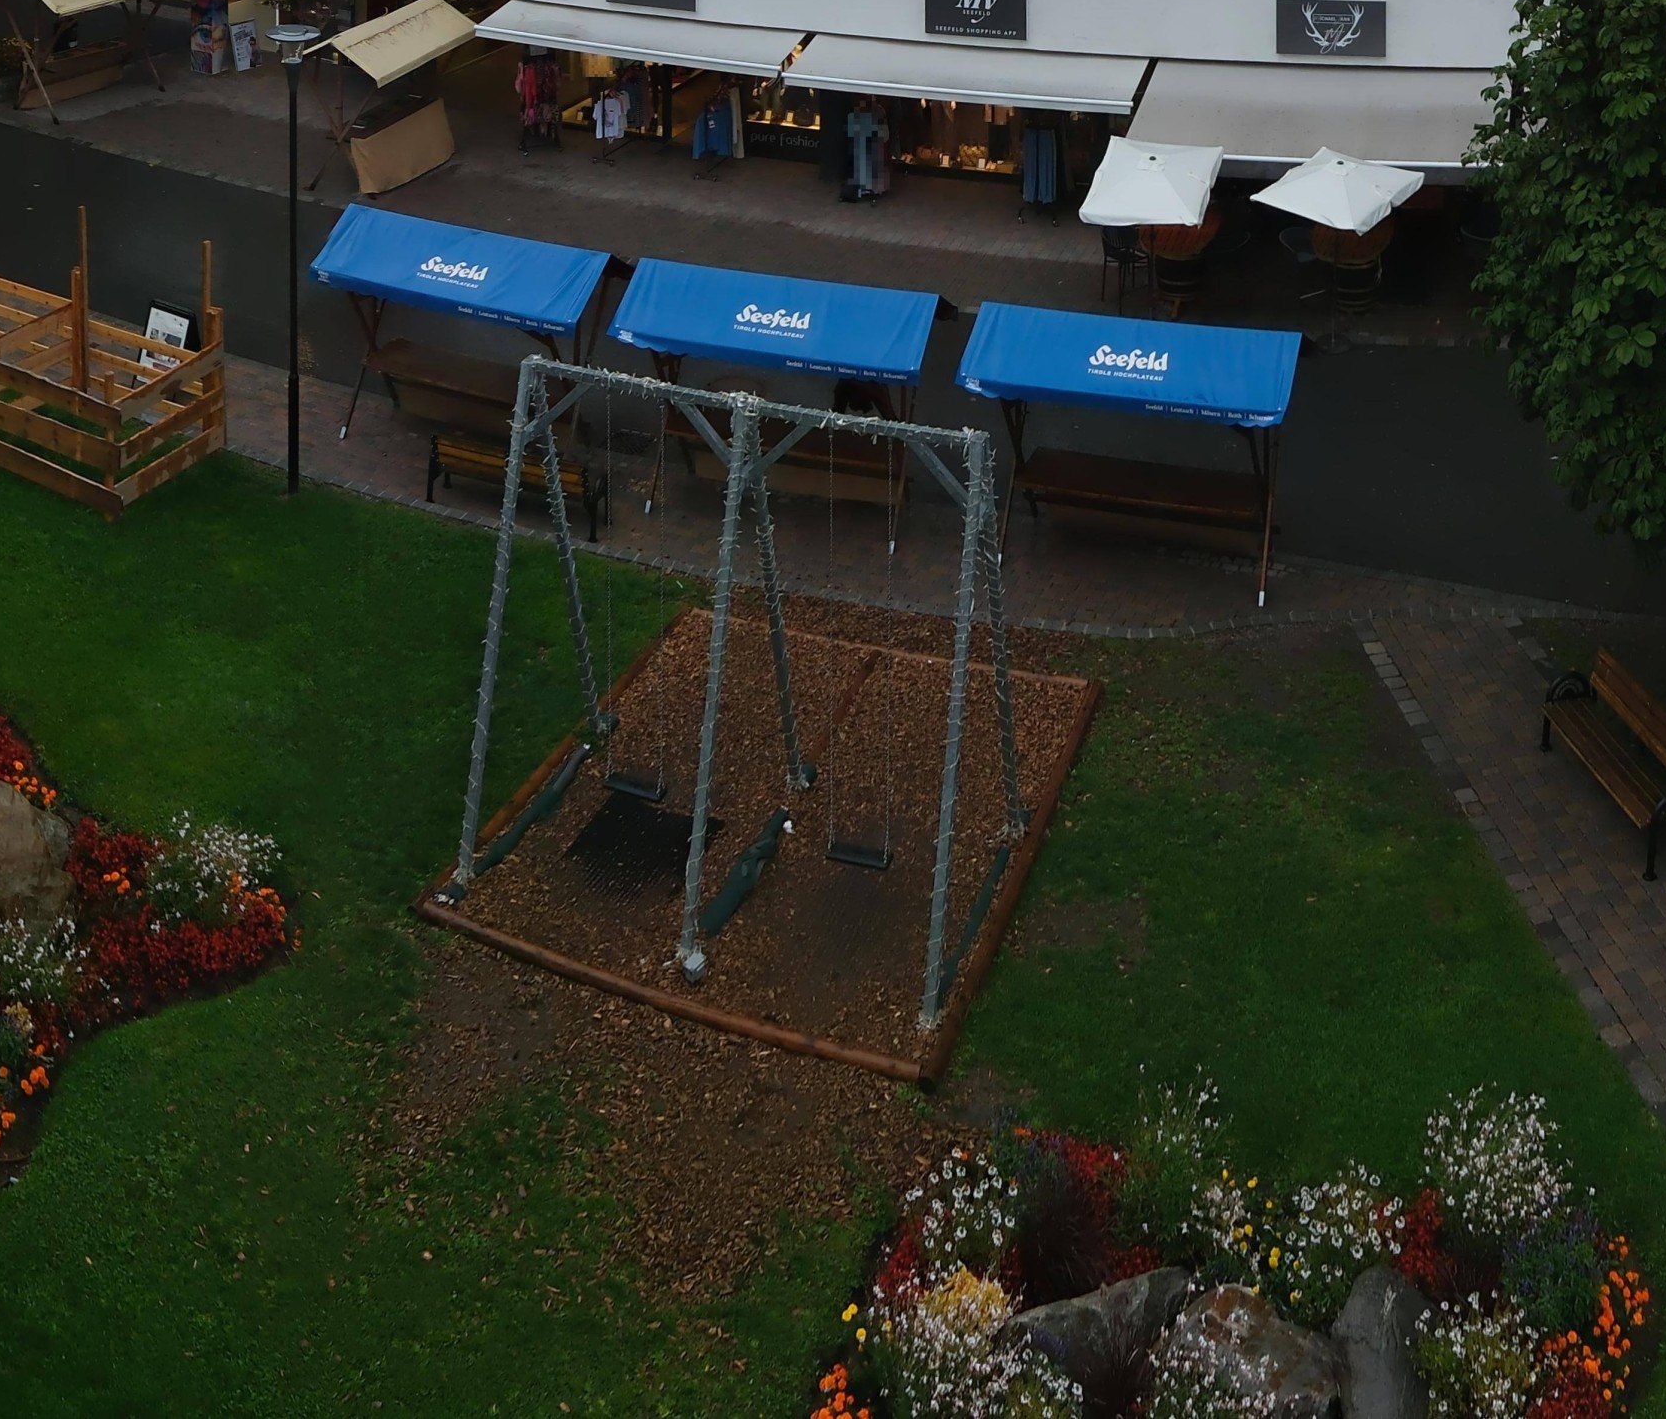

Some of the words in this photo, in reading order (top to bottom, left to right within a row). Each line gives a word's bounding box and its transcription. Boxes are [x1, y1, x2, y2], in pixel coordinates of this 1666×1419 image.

[935, 25, 964, 33] SEEFELD
[420, 256, 489, 281] Seefeld
[735, 304, 811, 330] Seefeld
[1089, 344, 1168, 372] Seefeld
[1087, 368, 1112, 376] TIROLS
[1114, 371, 1164, 381] HOCHPLATEAU
